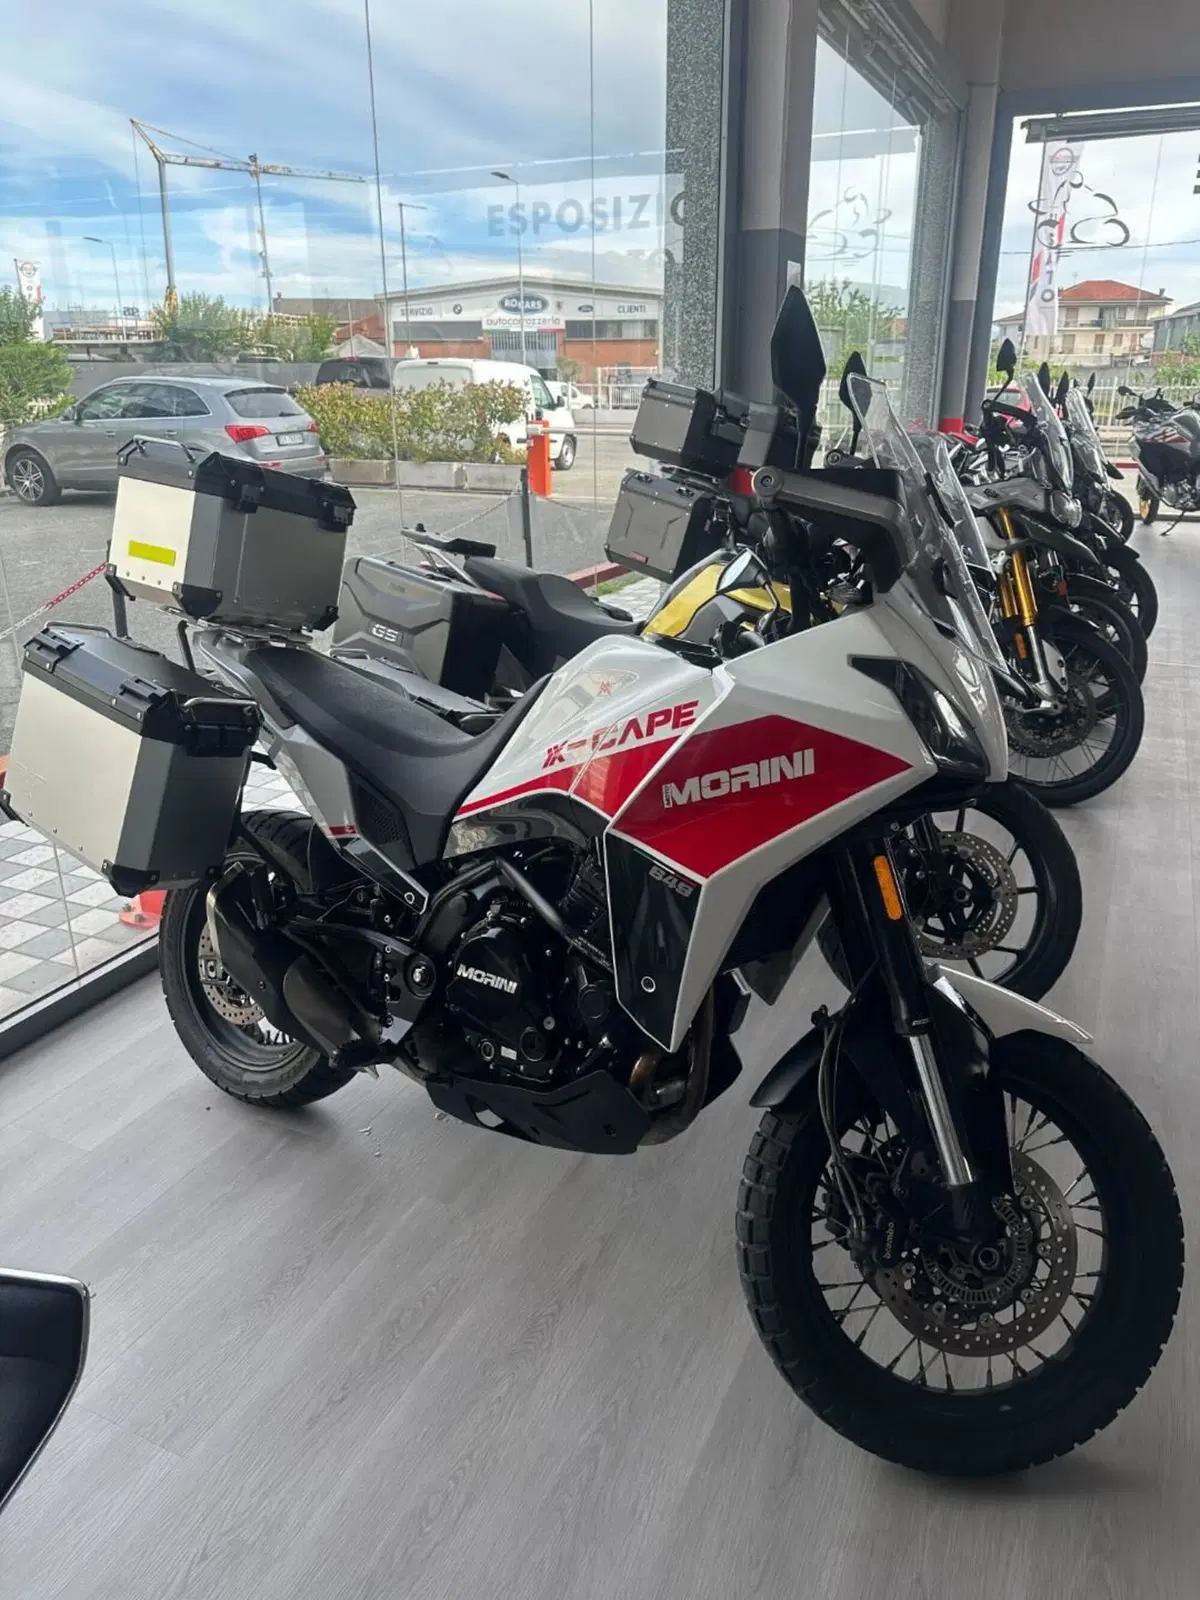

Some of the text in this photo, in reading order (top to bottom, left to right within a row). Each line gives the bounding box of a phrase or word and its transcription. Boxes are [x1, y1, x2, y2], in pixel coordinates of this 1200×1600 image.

[617, 304, 646, 313] CLIENTI
[372, 623, 400, 642] GS
[542, 701, 699, 769] X-CAPE
[668, 748, 815, 806] MORINI
[648, 865, 694, 898] 649
[456, 962, 519, 995] MORINI
[882, 1221, 895, 1260] brembo
